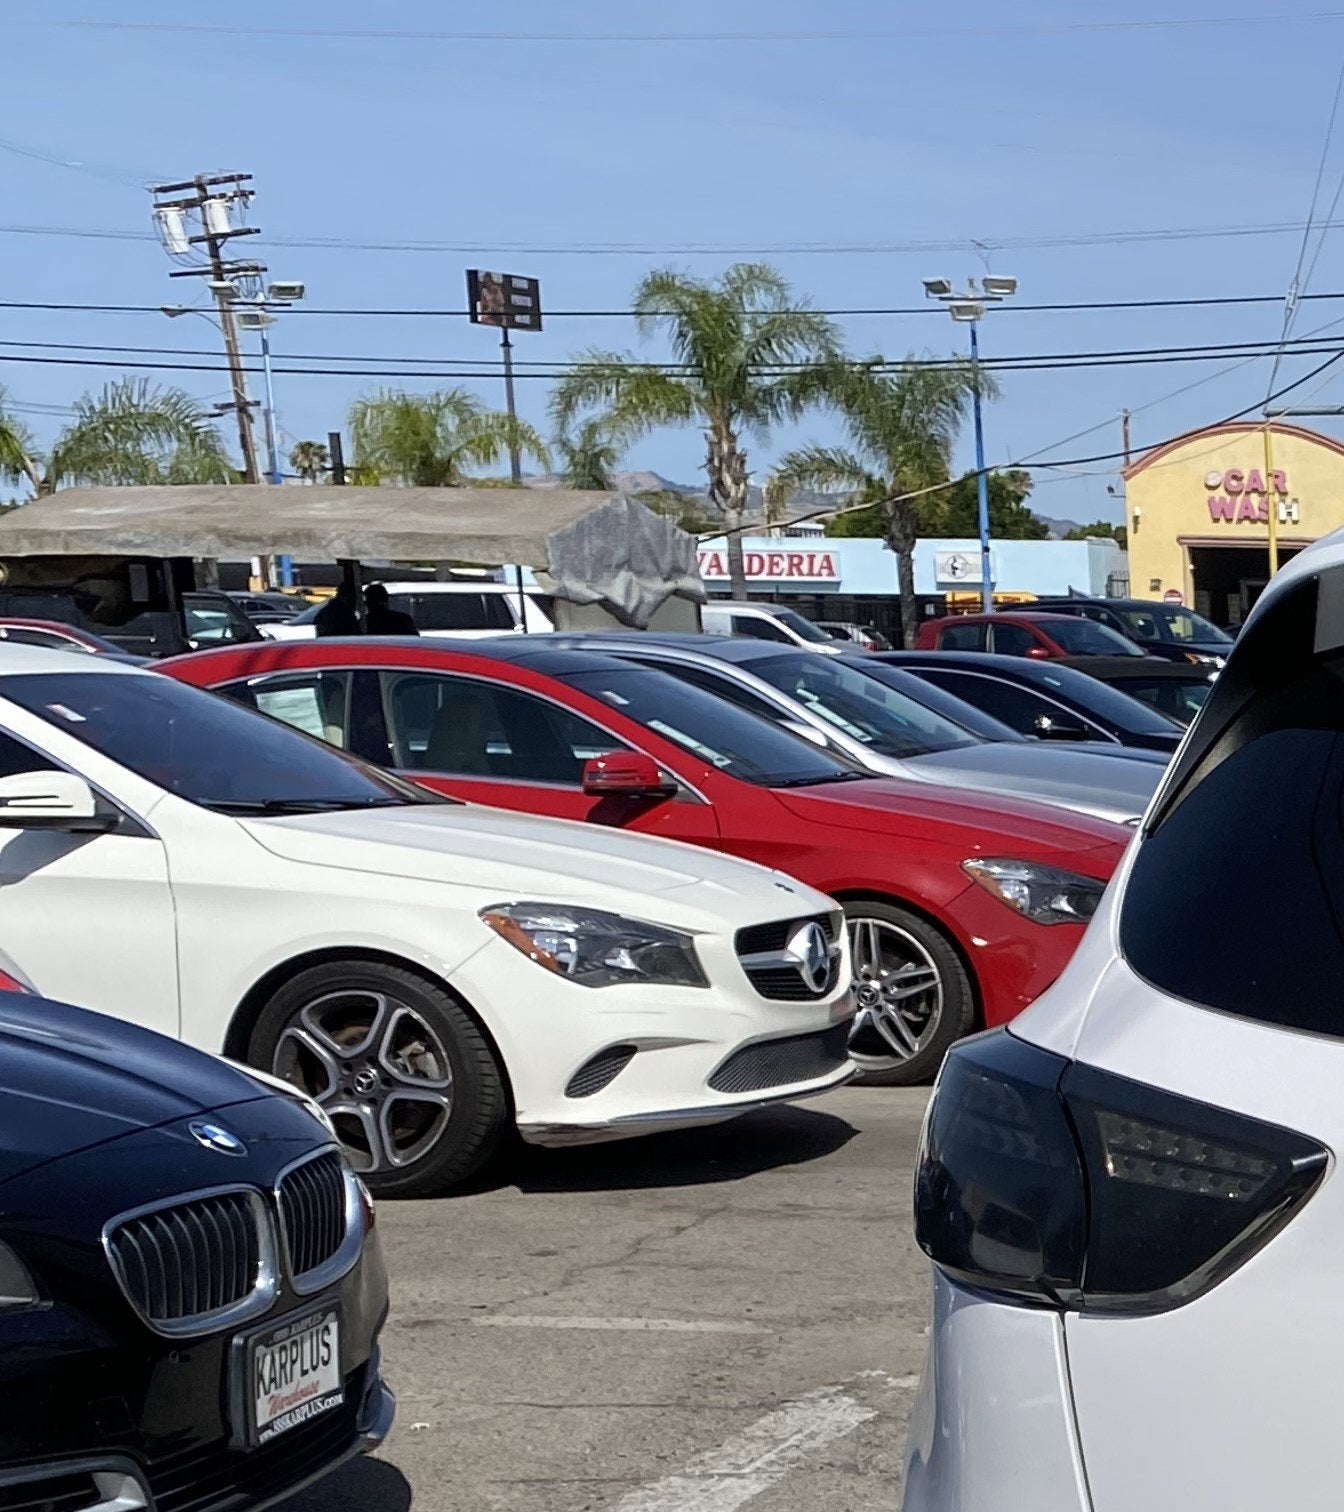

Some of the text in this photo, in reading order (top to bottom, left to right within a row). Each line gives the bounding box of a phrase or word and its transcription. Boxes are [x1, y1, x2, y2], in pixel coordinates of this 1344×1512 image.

[1224, 469, 1287, 492] CAR
[1208, 496, 1299, 522] WASH
[256, 1325, 331, 1400] KARPLUS
